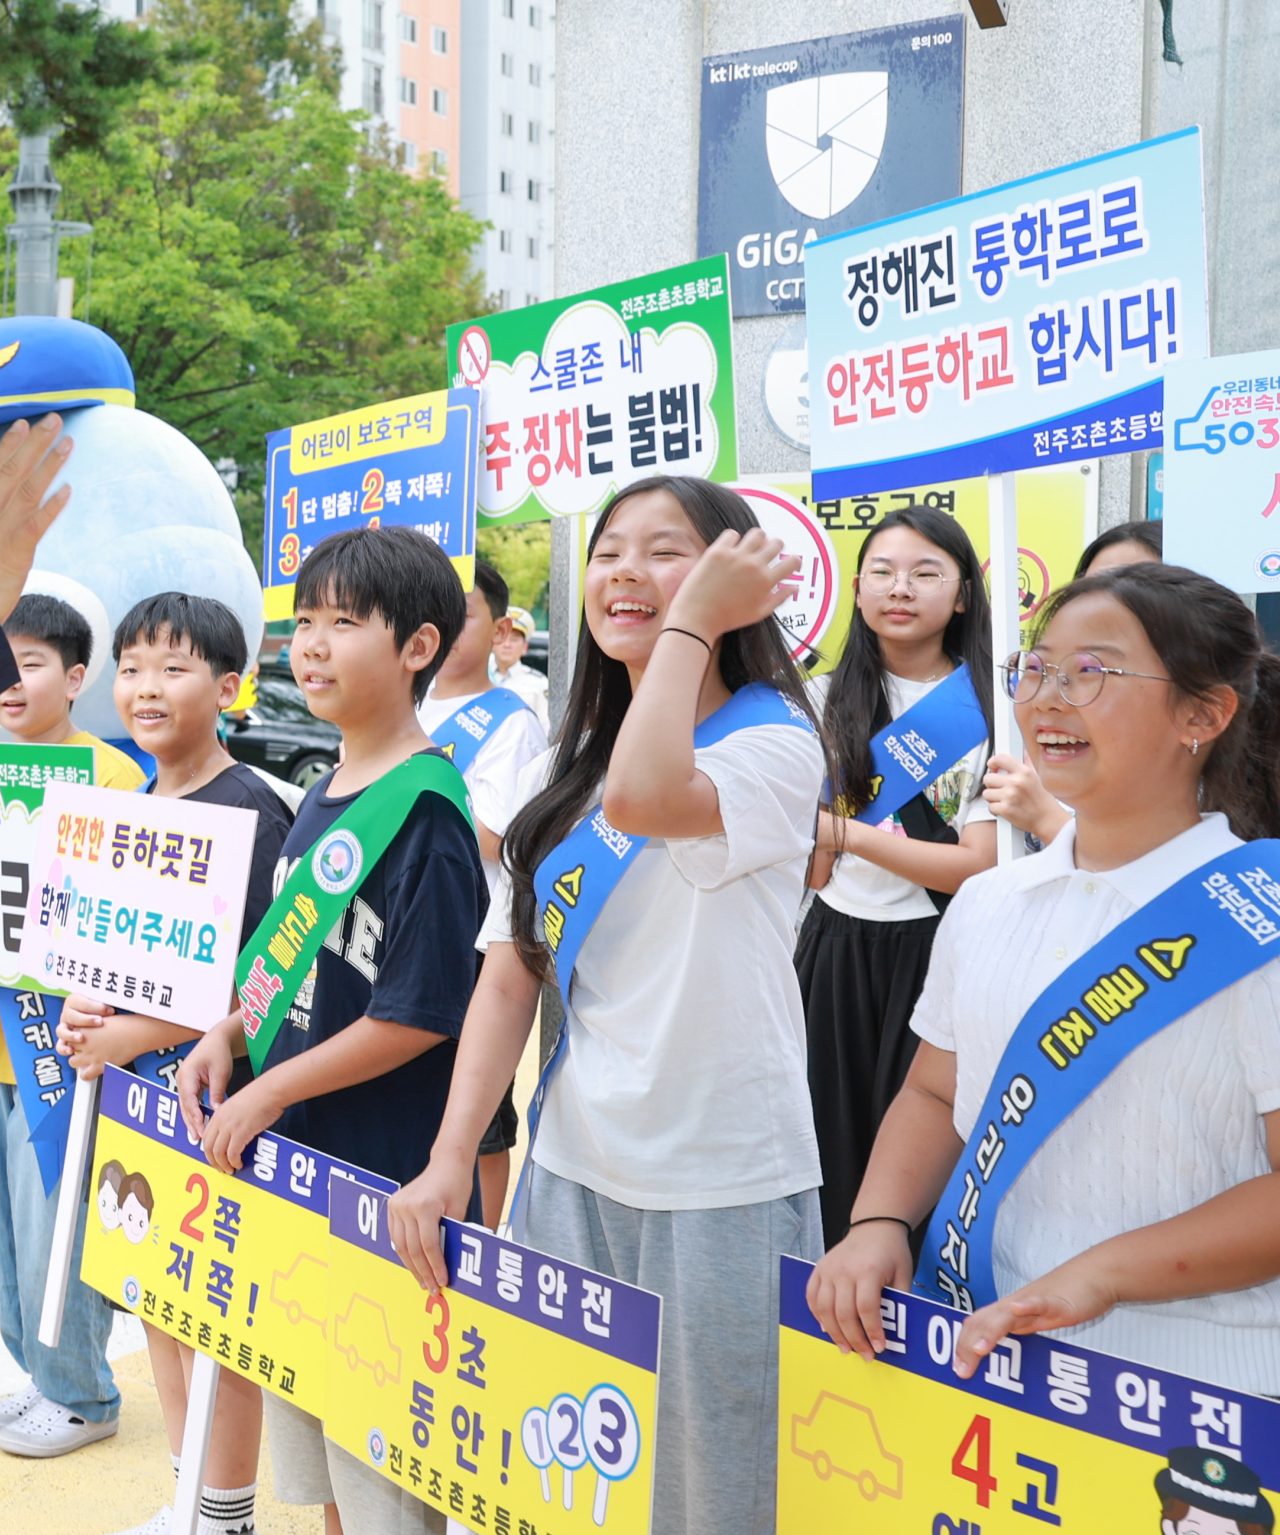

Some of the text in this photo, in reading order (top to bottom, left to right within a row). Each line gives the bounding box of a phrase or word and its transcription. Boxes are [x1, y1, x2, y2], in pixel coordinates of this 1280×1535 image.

[752, 59, 798, 77] telecop
[847, 185, 1144, 327] 정해진 통학로로
[620, 277, 724, 321] 전주조촌초등학교
[529, 330, 643, 393] 스쿨존 내
[826, 286, 1177, 427] 안전등하교 합시다!
[301, 407, 433, 460] 어린이 보호구역
[627, 382, 703, 468] 불법!
[321, 490, 359, 520] 멈춤!
[407, 472, 452, 501] 저쪽!
[883, 734, 929, 782] 학부모회
[56, 813, 214, 885] 안전한 등하굣길
[38, 883, 72, 928] 함께
[75, 894, 218, 966] 만들어주세요
[1201, 871, 1280, 946] 학부모회
[55, 954, 174, 1009] 전주조촌초등학교
[284, 1008, 311, 1028] THLETIC
[1038, 933, 1198, 1071] 스쿨존
[179, 1172, 242, 1254] 2쪽
[143, 1290, 297, 1395] 전주조촌초등학교
[422, 1293, 487, 1390] 3초
[950, 1414, 1062, 1527] 4고
